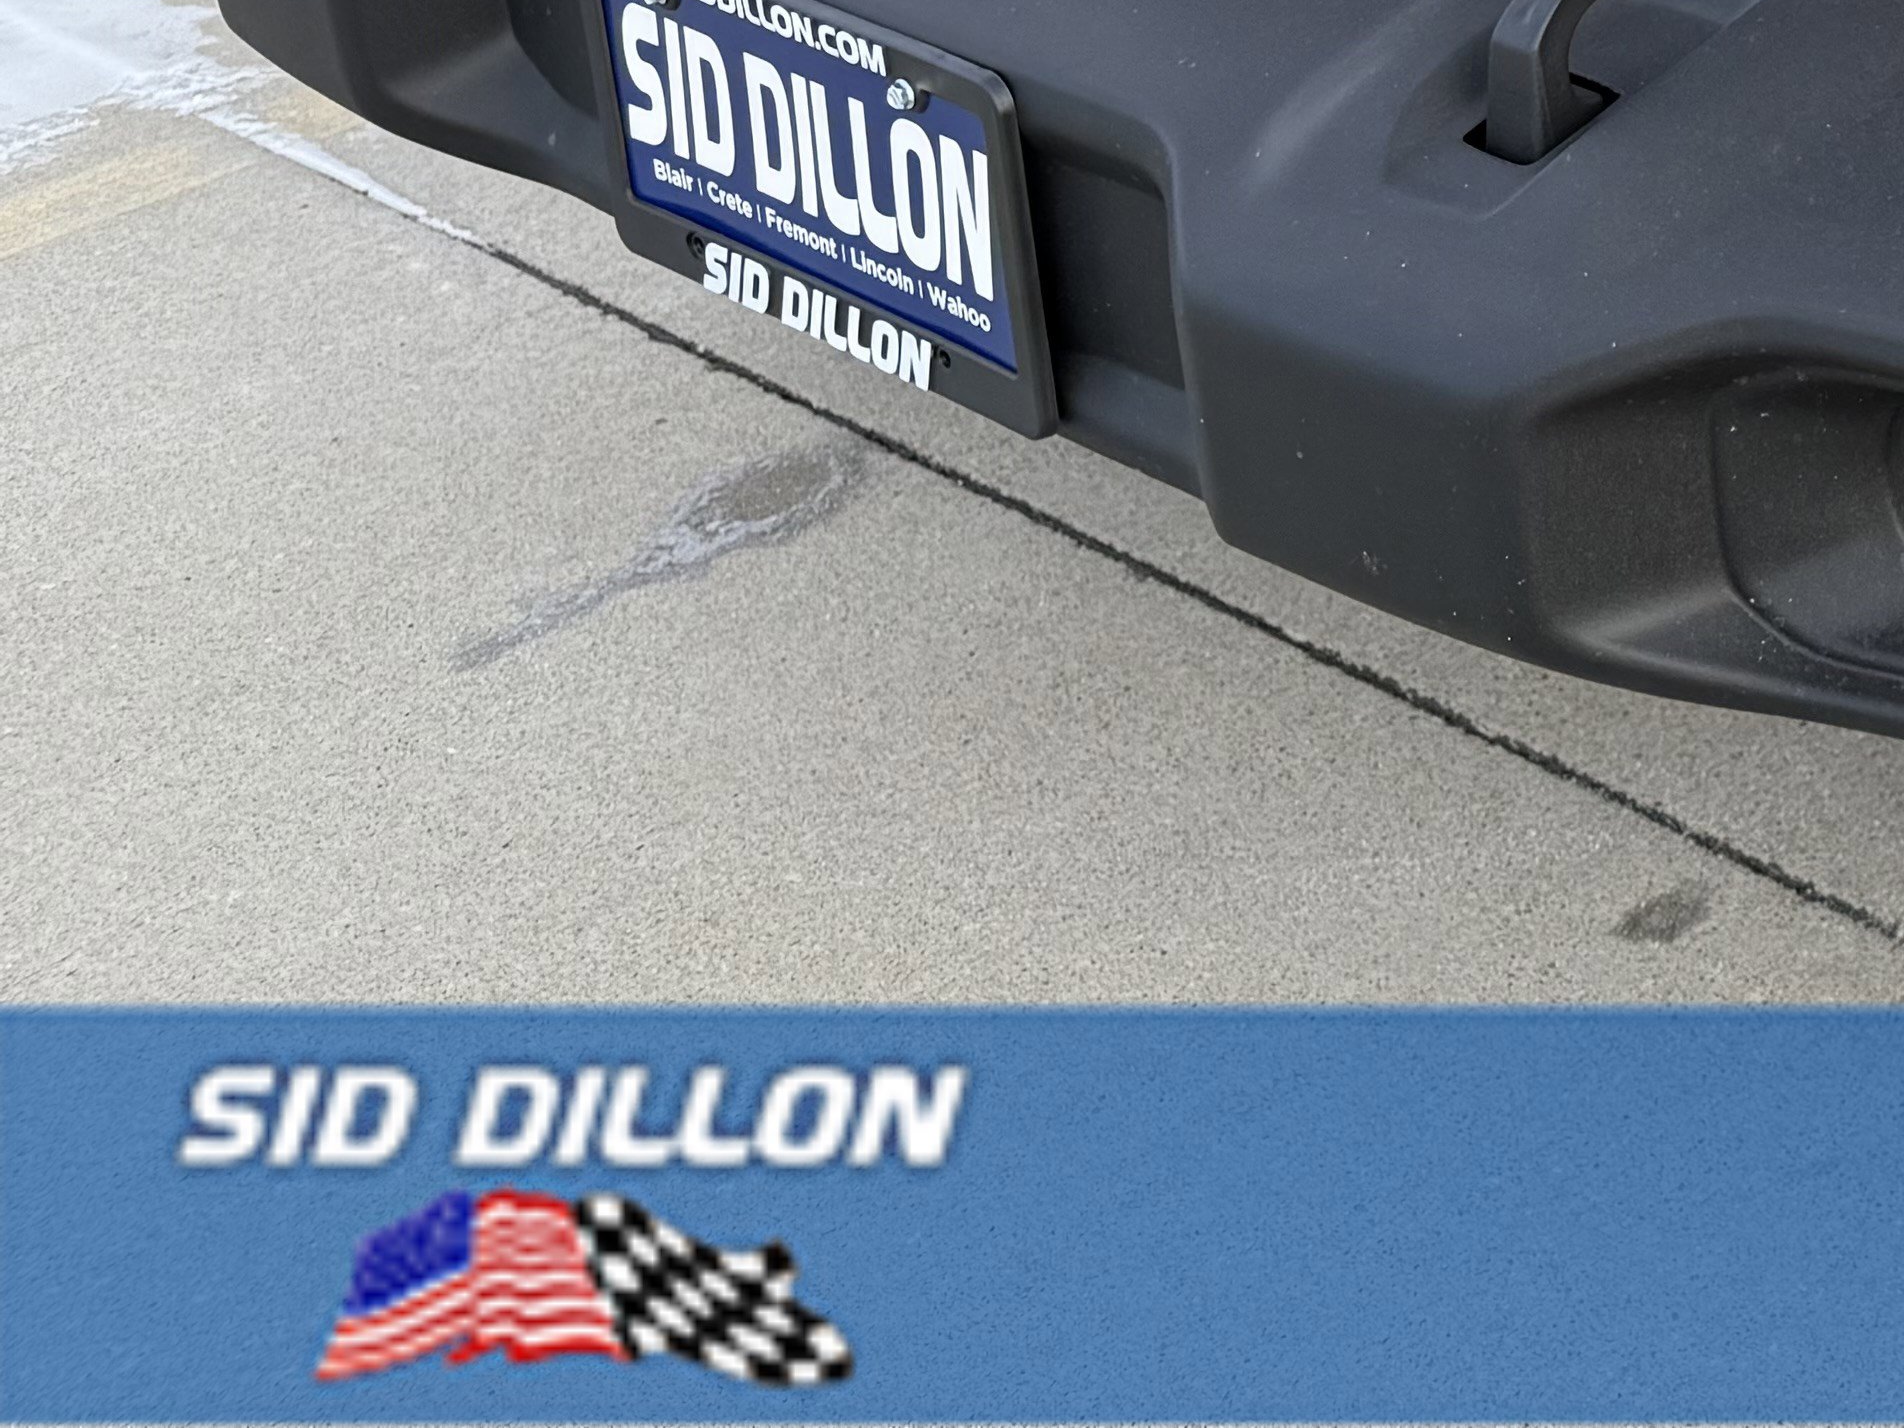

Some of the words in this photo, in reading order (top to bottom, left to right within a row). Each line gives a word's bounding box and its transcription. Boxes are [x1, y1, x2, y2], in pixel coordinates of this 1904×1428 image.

[621, 0, 735, 178] SID
[743, 51, 994, 303] DILLON
[652, 157, 694, 194] Blair
[706, 180, 753, 220] Crete
[765, 207, 838, 260] Fremont
[850, 246, 915, 296] Lincoln
[927, 282, 992, 334] Wahoo
[702, 241, 770, 315] SID
[781, 274, 933, 392] DILLON
